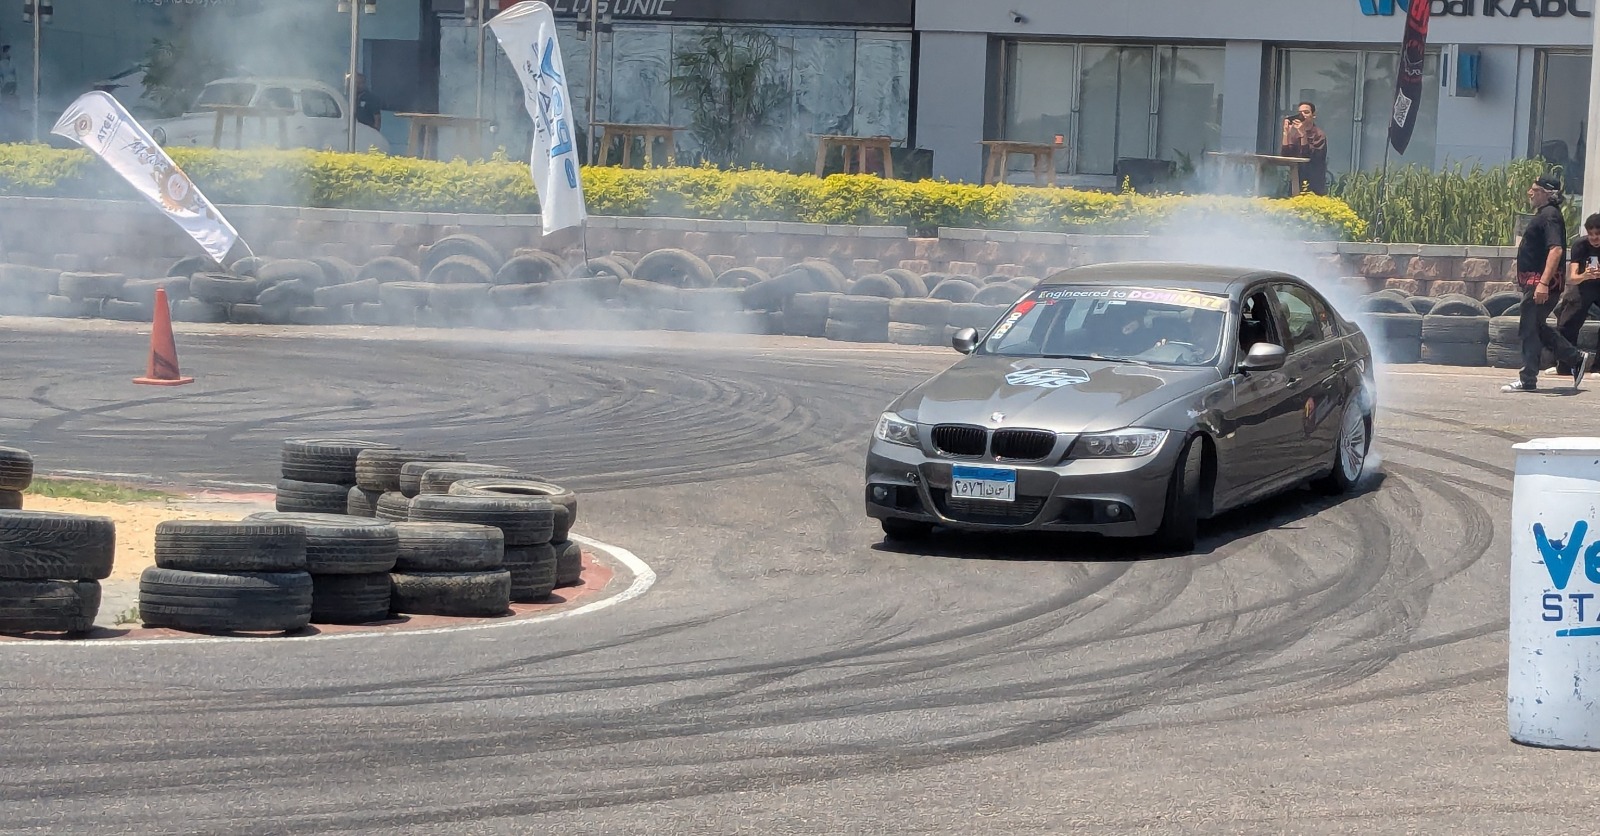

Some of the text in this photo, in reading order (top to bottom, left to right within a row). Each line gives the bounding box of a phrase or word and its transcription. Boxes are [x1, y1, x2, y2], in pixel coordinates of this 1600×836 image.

[1038, 289, 1110, 299] Engineered
[1113, 290, 1127, 299] to
[1542, 593, 1600, 622] ST
